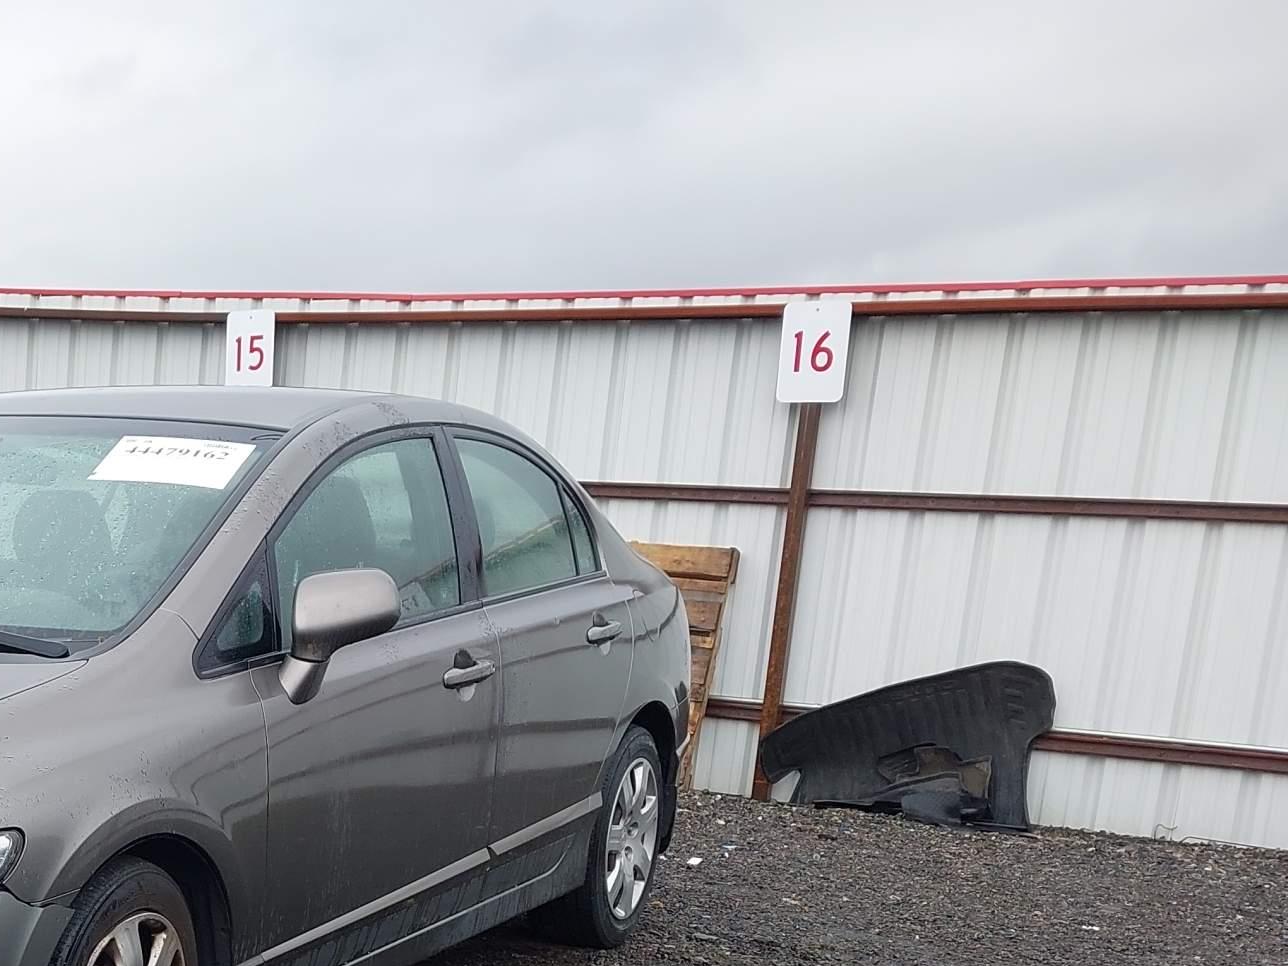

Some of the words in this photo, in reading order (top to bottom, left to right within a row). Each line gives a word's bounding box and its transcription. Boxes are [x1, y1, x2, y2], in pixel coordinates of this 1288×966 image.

[235, 334, 264, 372] 15
[793, 330, 834, 373] 16
[126, 446, 229, 460] 44479162
